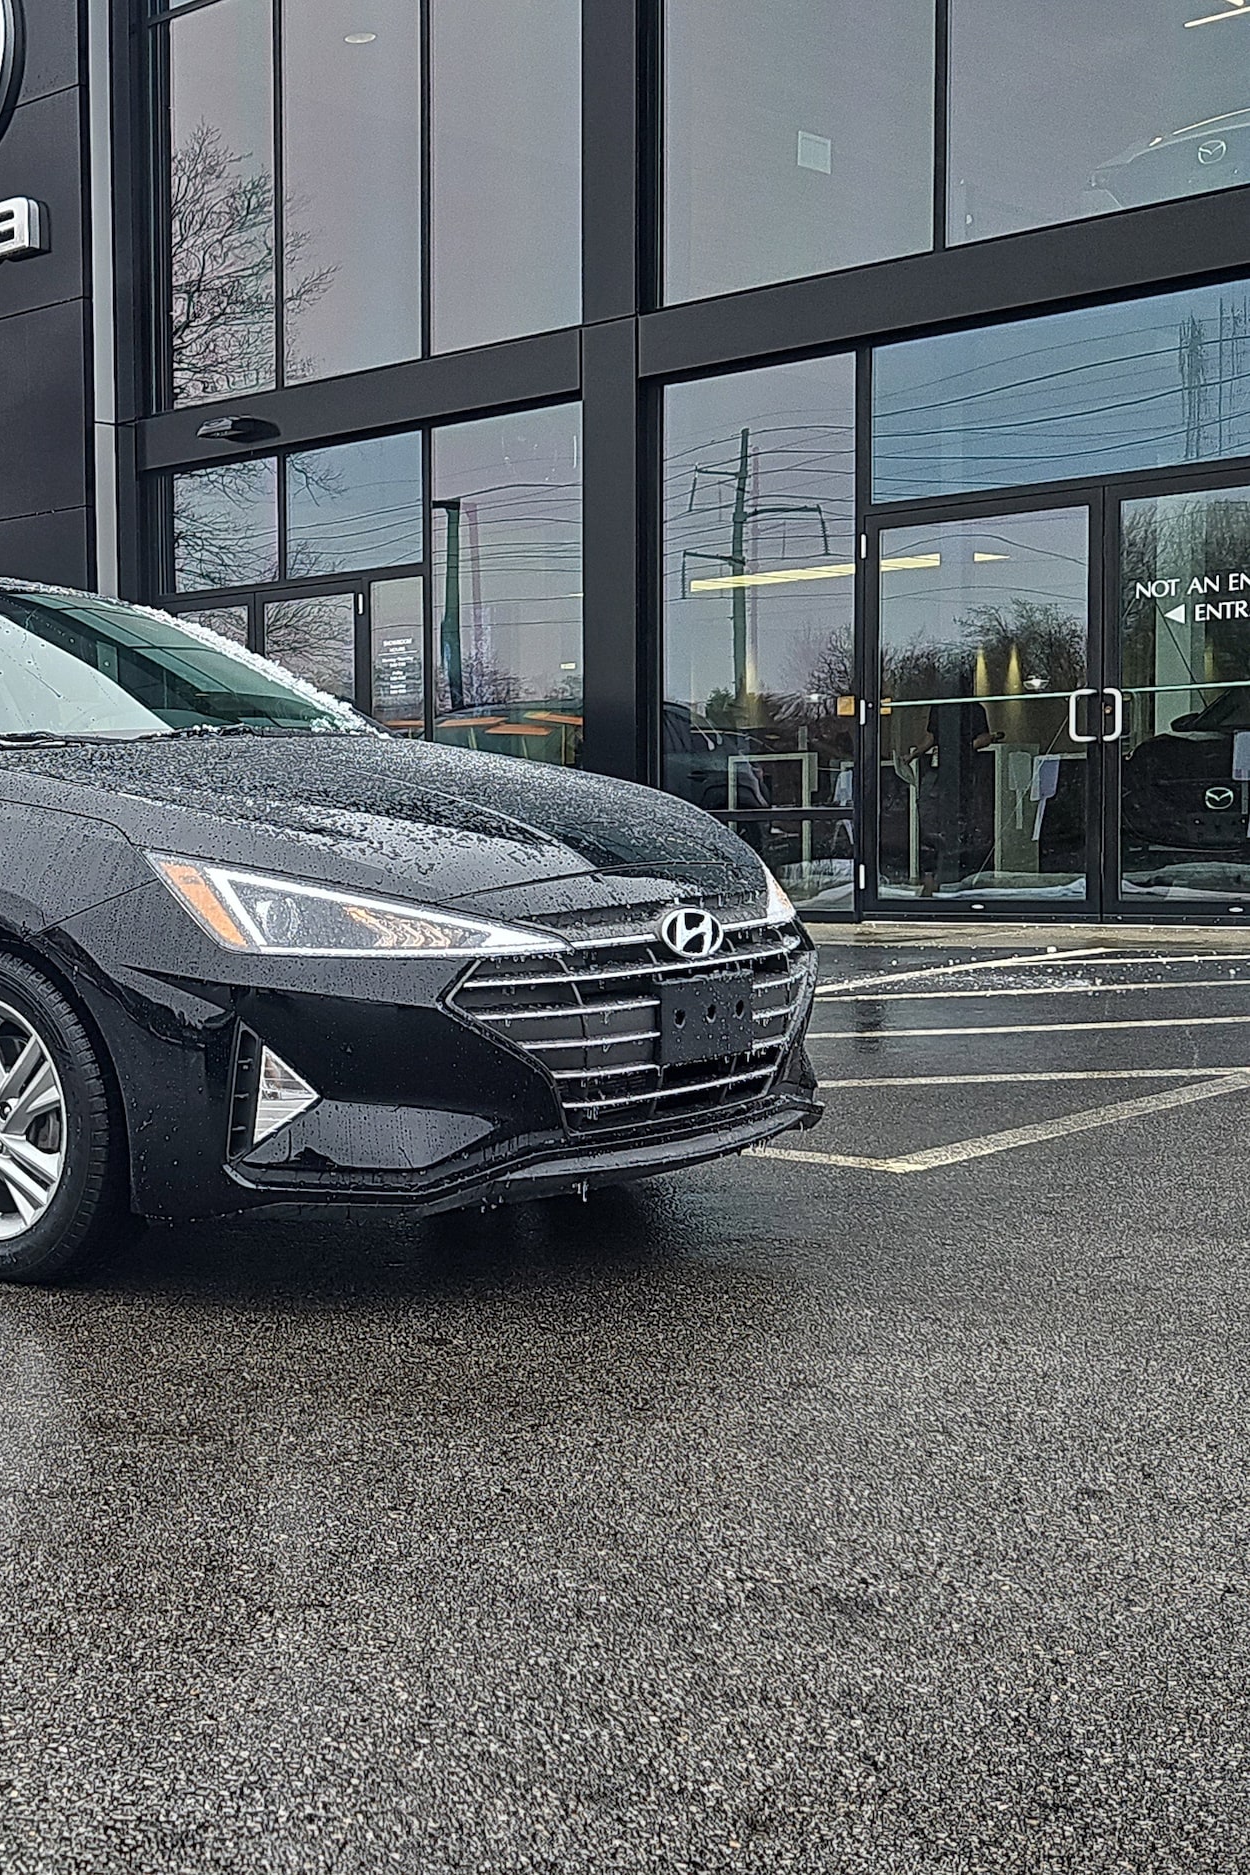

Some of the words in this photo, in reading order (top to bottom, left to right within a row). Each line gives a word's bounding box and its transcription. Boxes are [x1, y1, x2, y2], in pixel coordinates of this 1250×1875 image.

[1135, 578, 1180, 599] NOT
[1187, 574, 1220, 595] AN
[1194, 599, 1250, 621] ENTR
